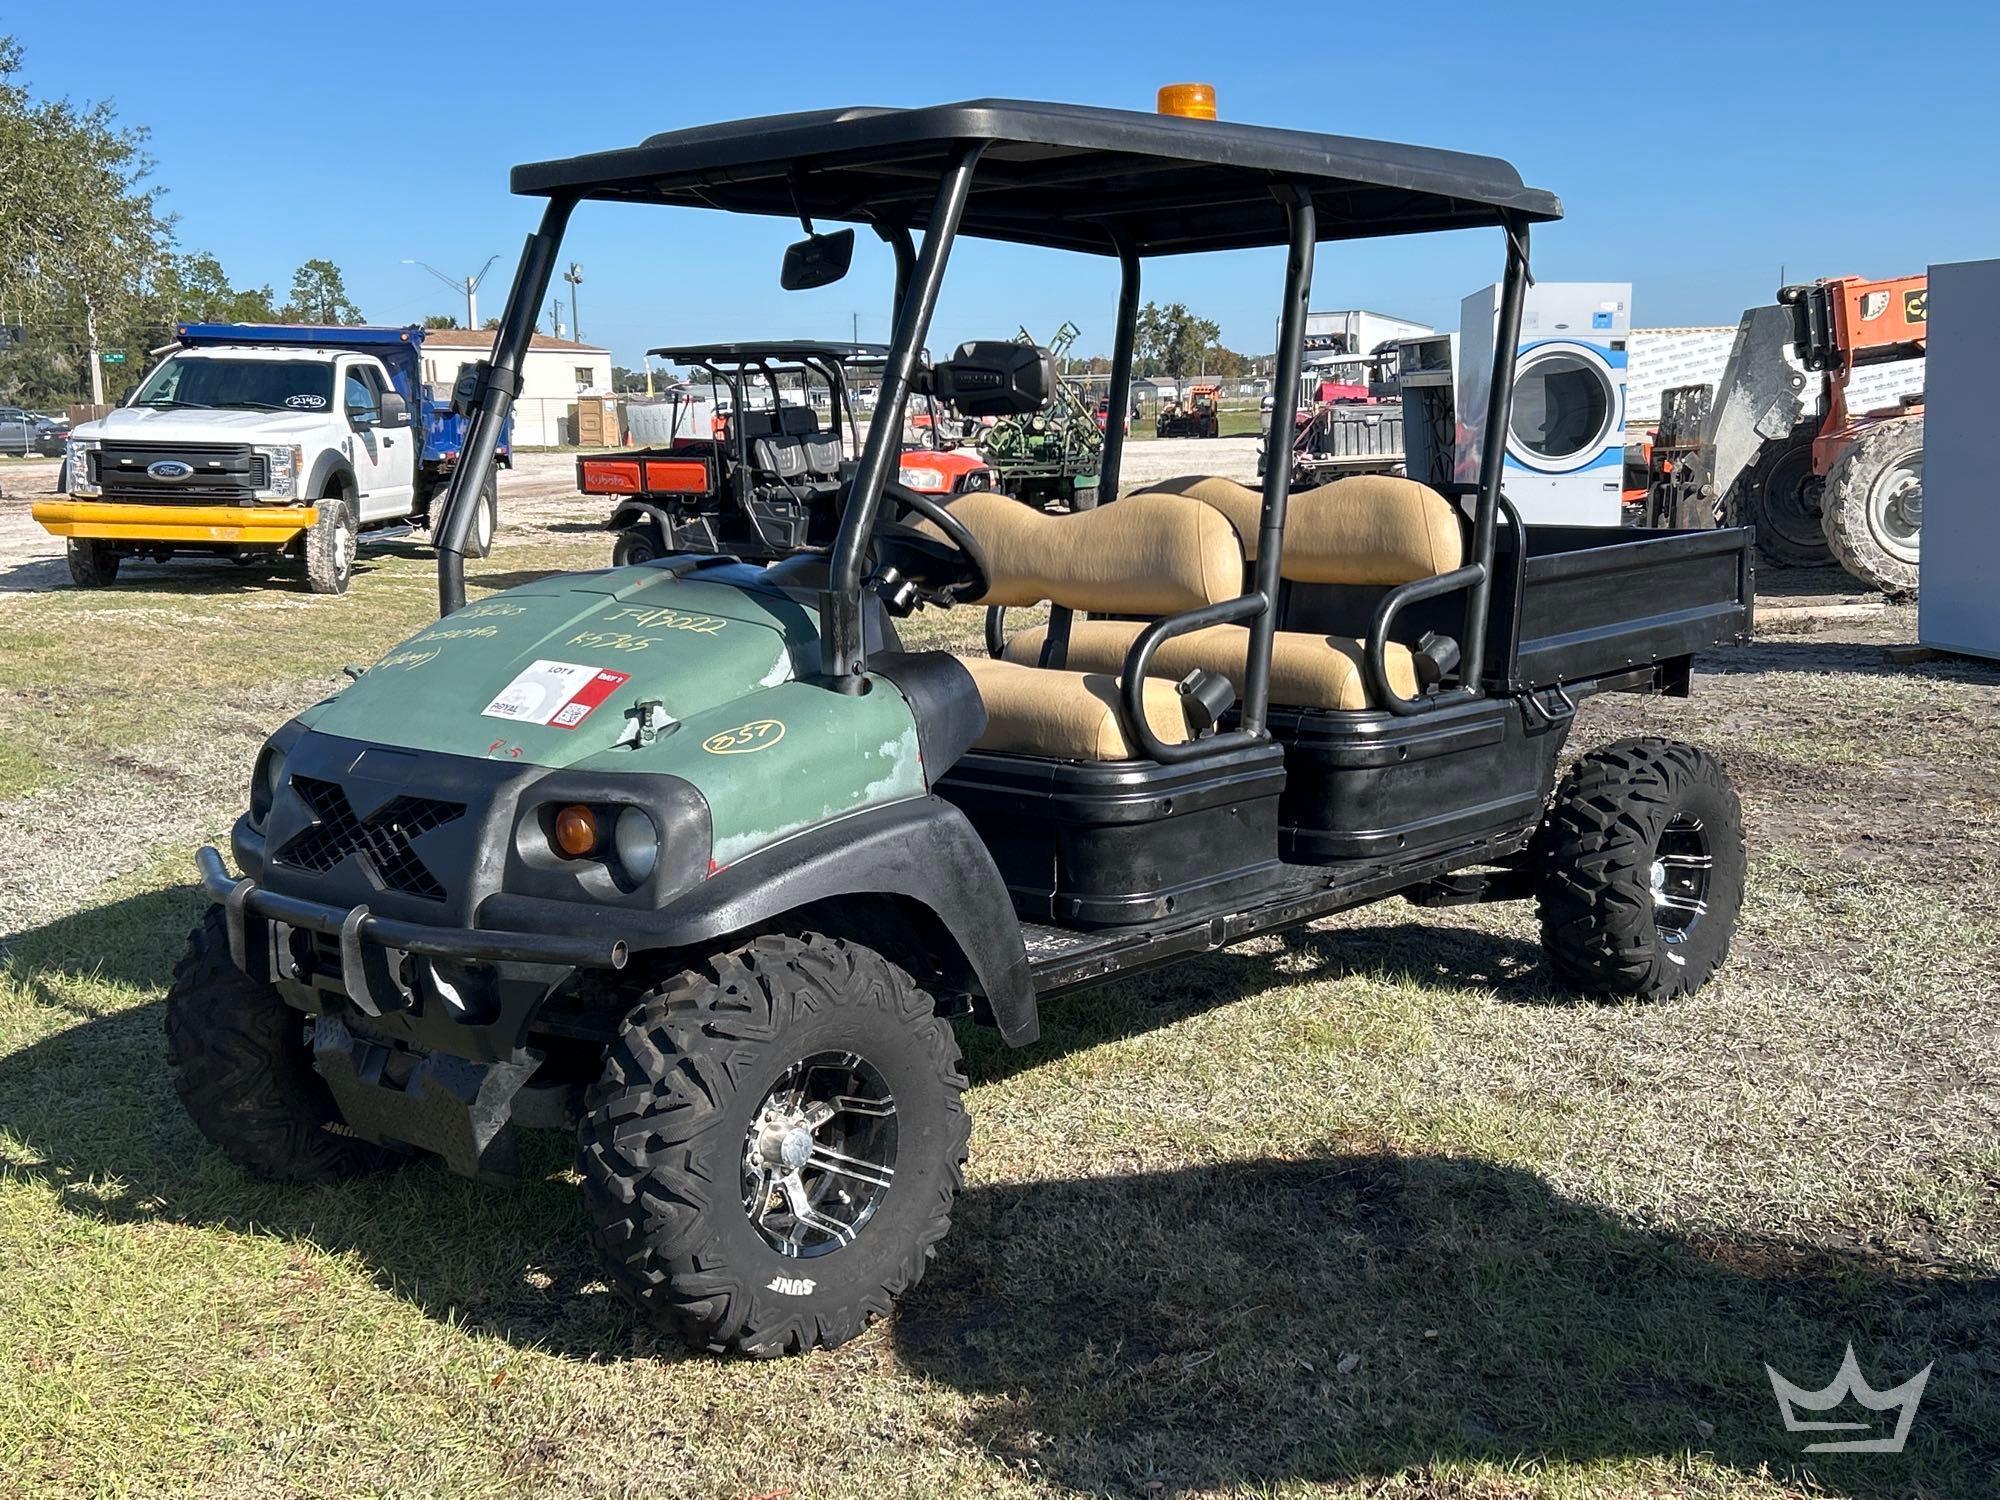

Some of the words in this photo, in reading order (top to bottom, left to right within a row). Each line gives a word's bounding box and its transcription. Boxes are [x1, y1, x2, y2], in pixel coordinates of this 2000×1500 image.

[587, 474, 624, 486] Kubota
[548, 666, 568, 674] LOT
[598, 672, 618, 682] DAY
[490, 702, 519, 713] ROYAL
[320, 1121, 359, 1137] UNF
[764, 1276, 817, 1296] SUNF
